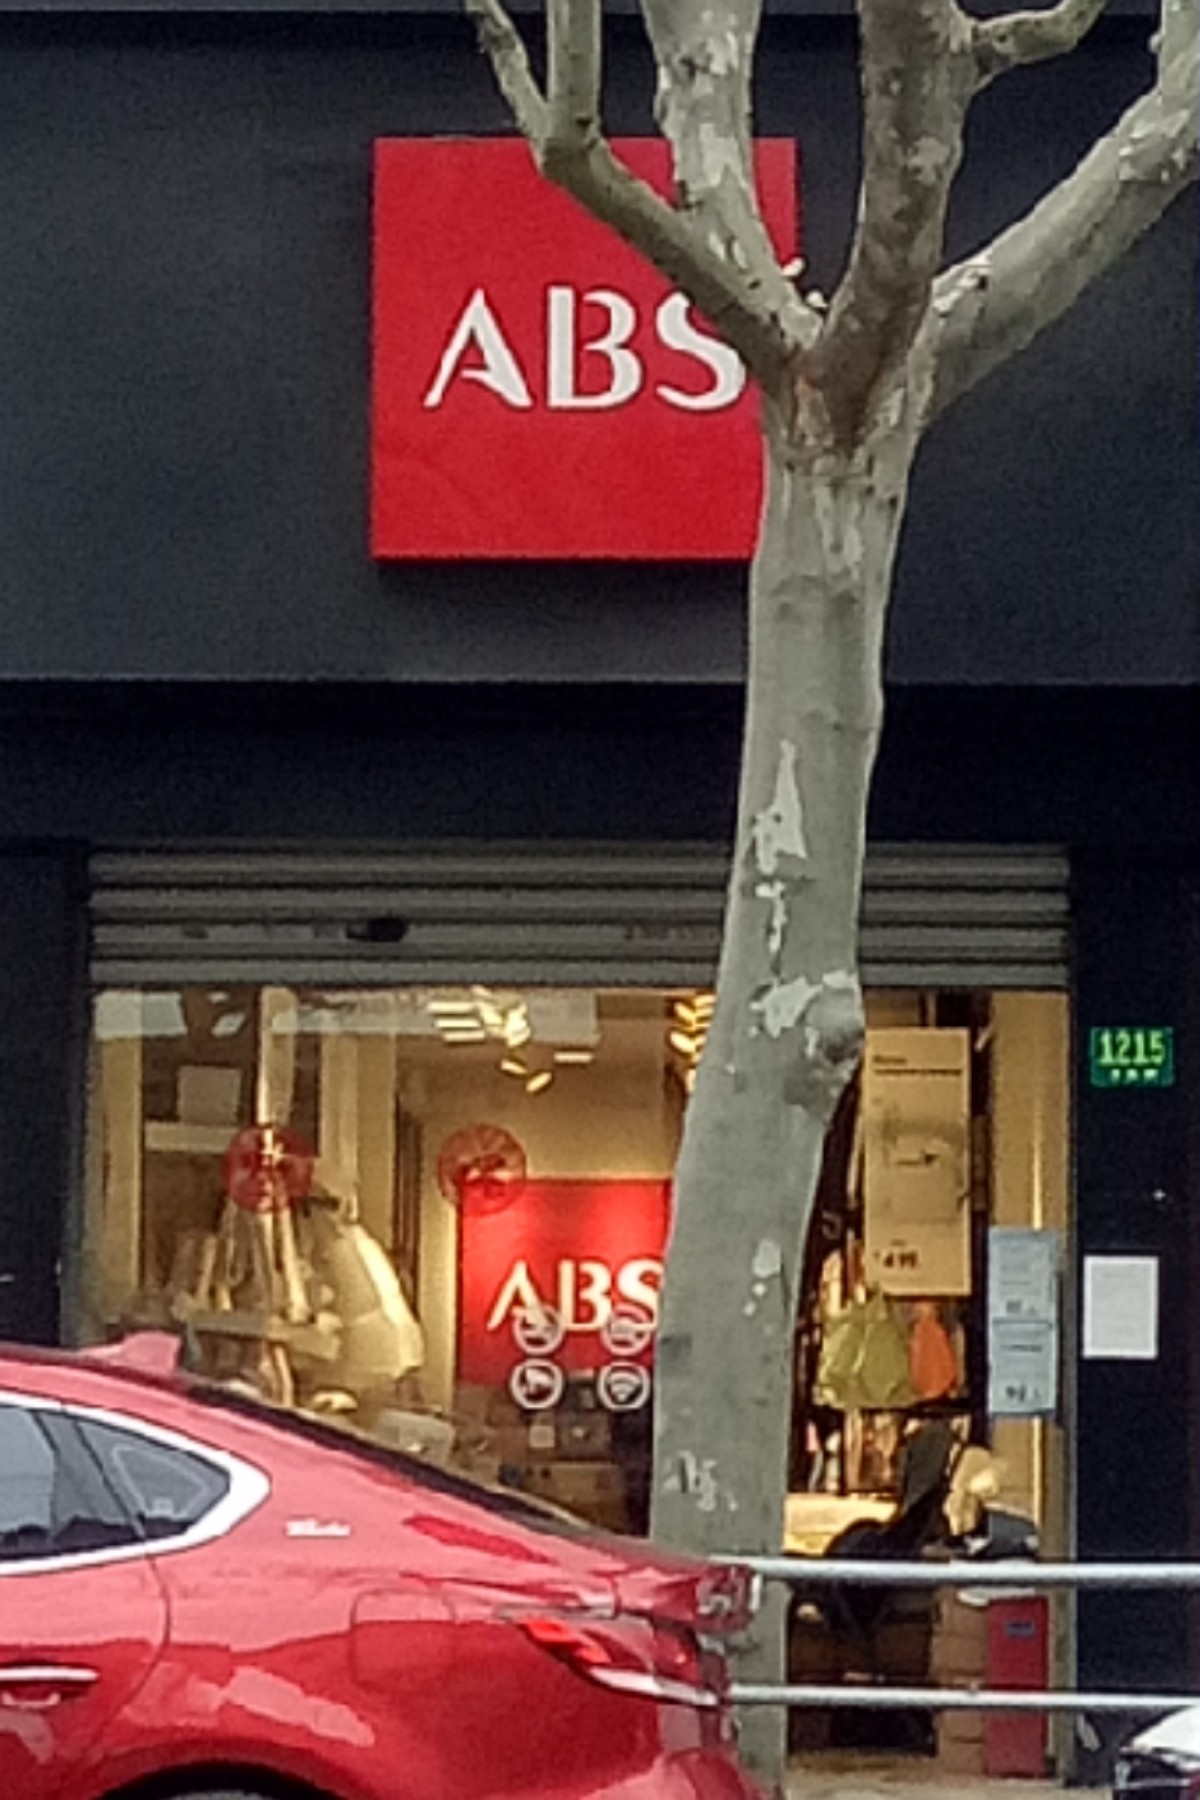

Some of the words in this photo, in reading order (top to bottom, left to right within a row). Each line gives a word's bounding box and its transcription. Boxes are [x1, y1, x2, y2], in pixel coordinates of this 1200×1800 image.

[423, 287, 747, 410] ABS
[1099, 1030, 1165, 1067] 1215
[487, 1257, 661, 1332] ABS
